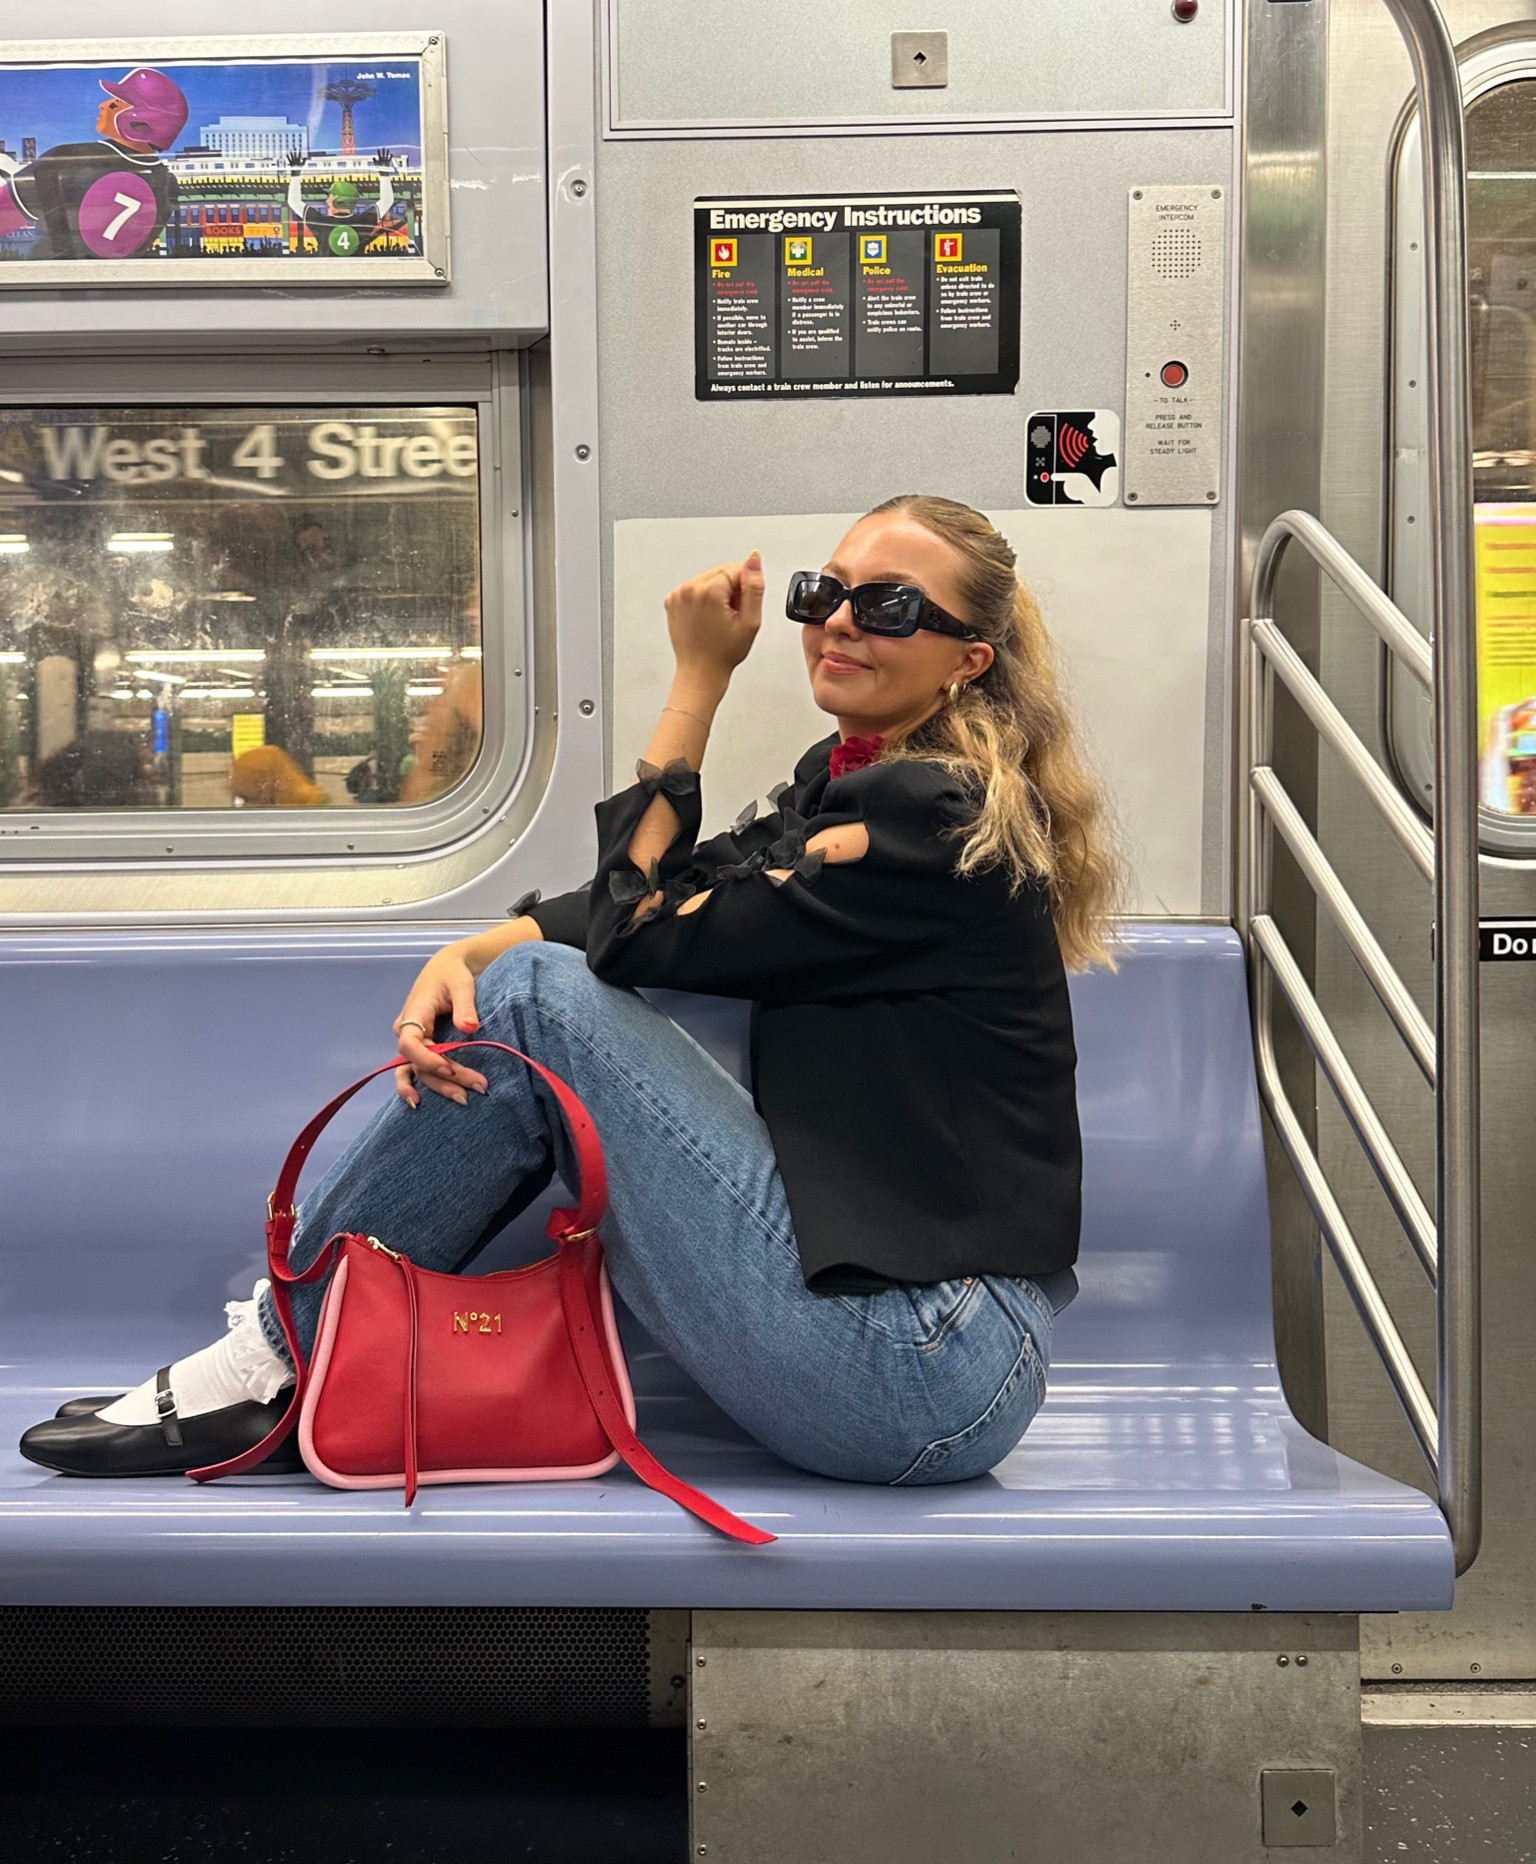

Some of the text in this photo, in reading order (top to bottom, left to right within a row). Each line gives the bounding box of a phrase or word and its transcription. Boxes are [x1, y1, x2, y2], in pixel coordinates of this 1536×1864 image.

[102, 192, 142, 241] 7
[710, 205, 981, 233] Emergency Instructions
[206, 227, 241, 235] BOOKS
[337, 231, 350, 250] 4
[712, 269, 731, 279] Fire
[787, 267, 824, 277] Medical
[863, 266, 891, 275] Police
[936, 263, 988, 273] Evacuation
[710, 383, 737, 393] Always
[737, 384, 765, 392] contact
[774, 383, 792, 391] train
[812, 381, 843, 390] member
[843, 381, 858, 389] and
[859, 380, 880, 389] listen
[881, 380, 893, 389] for
[894, 380, 955, 388] announcements.
[38, 427, 206, 481] West
[232, 425, 284, 478] 4
[1493, 933, 1528, 955] Do
